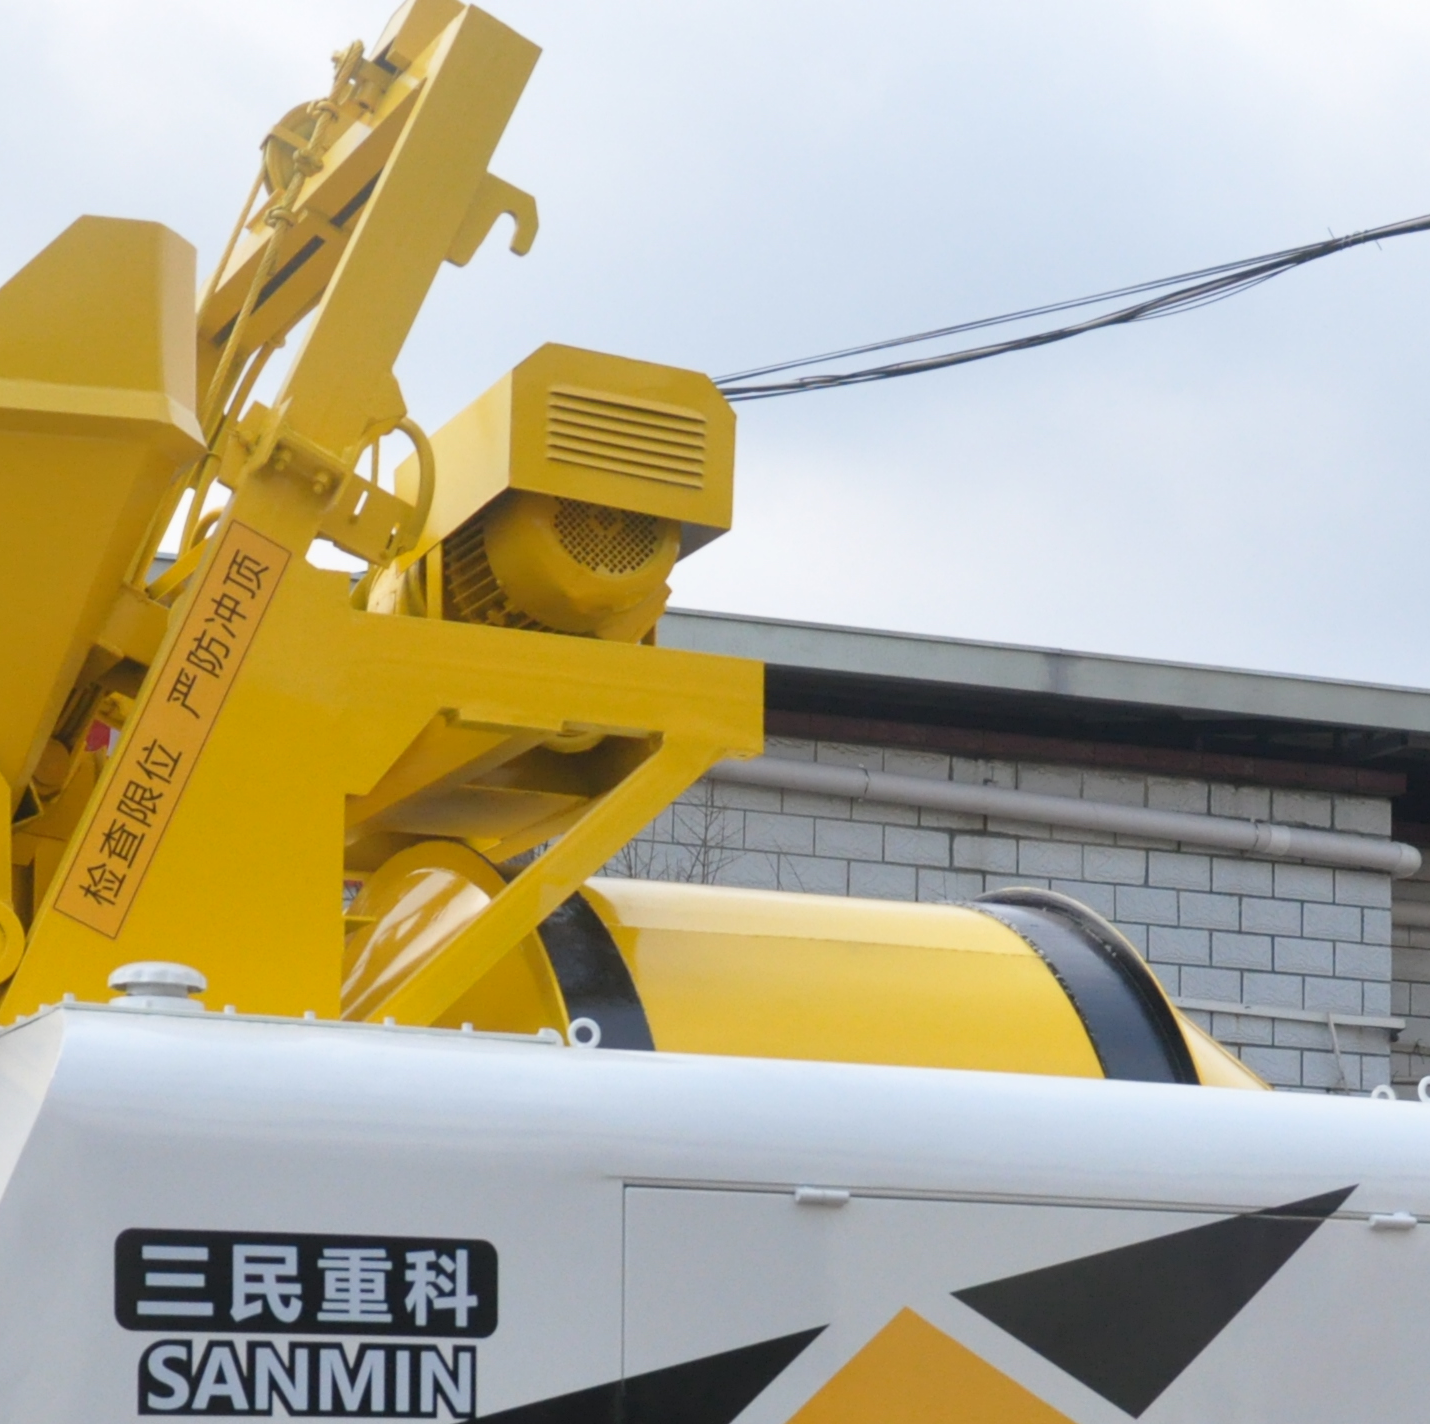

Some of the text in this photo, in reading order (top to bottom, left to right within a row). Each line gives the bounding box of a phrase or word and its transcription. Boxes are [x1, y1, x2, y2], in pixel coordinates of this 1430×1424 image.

[79, 548, 270, 906] 检查限位 严防冲顶
[136, 1243, 478, 1328] 三民重科
[146, 1343, 472, 1414] SANMIN
